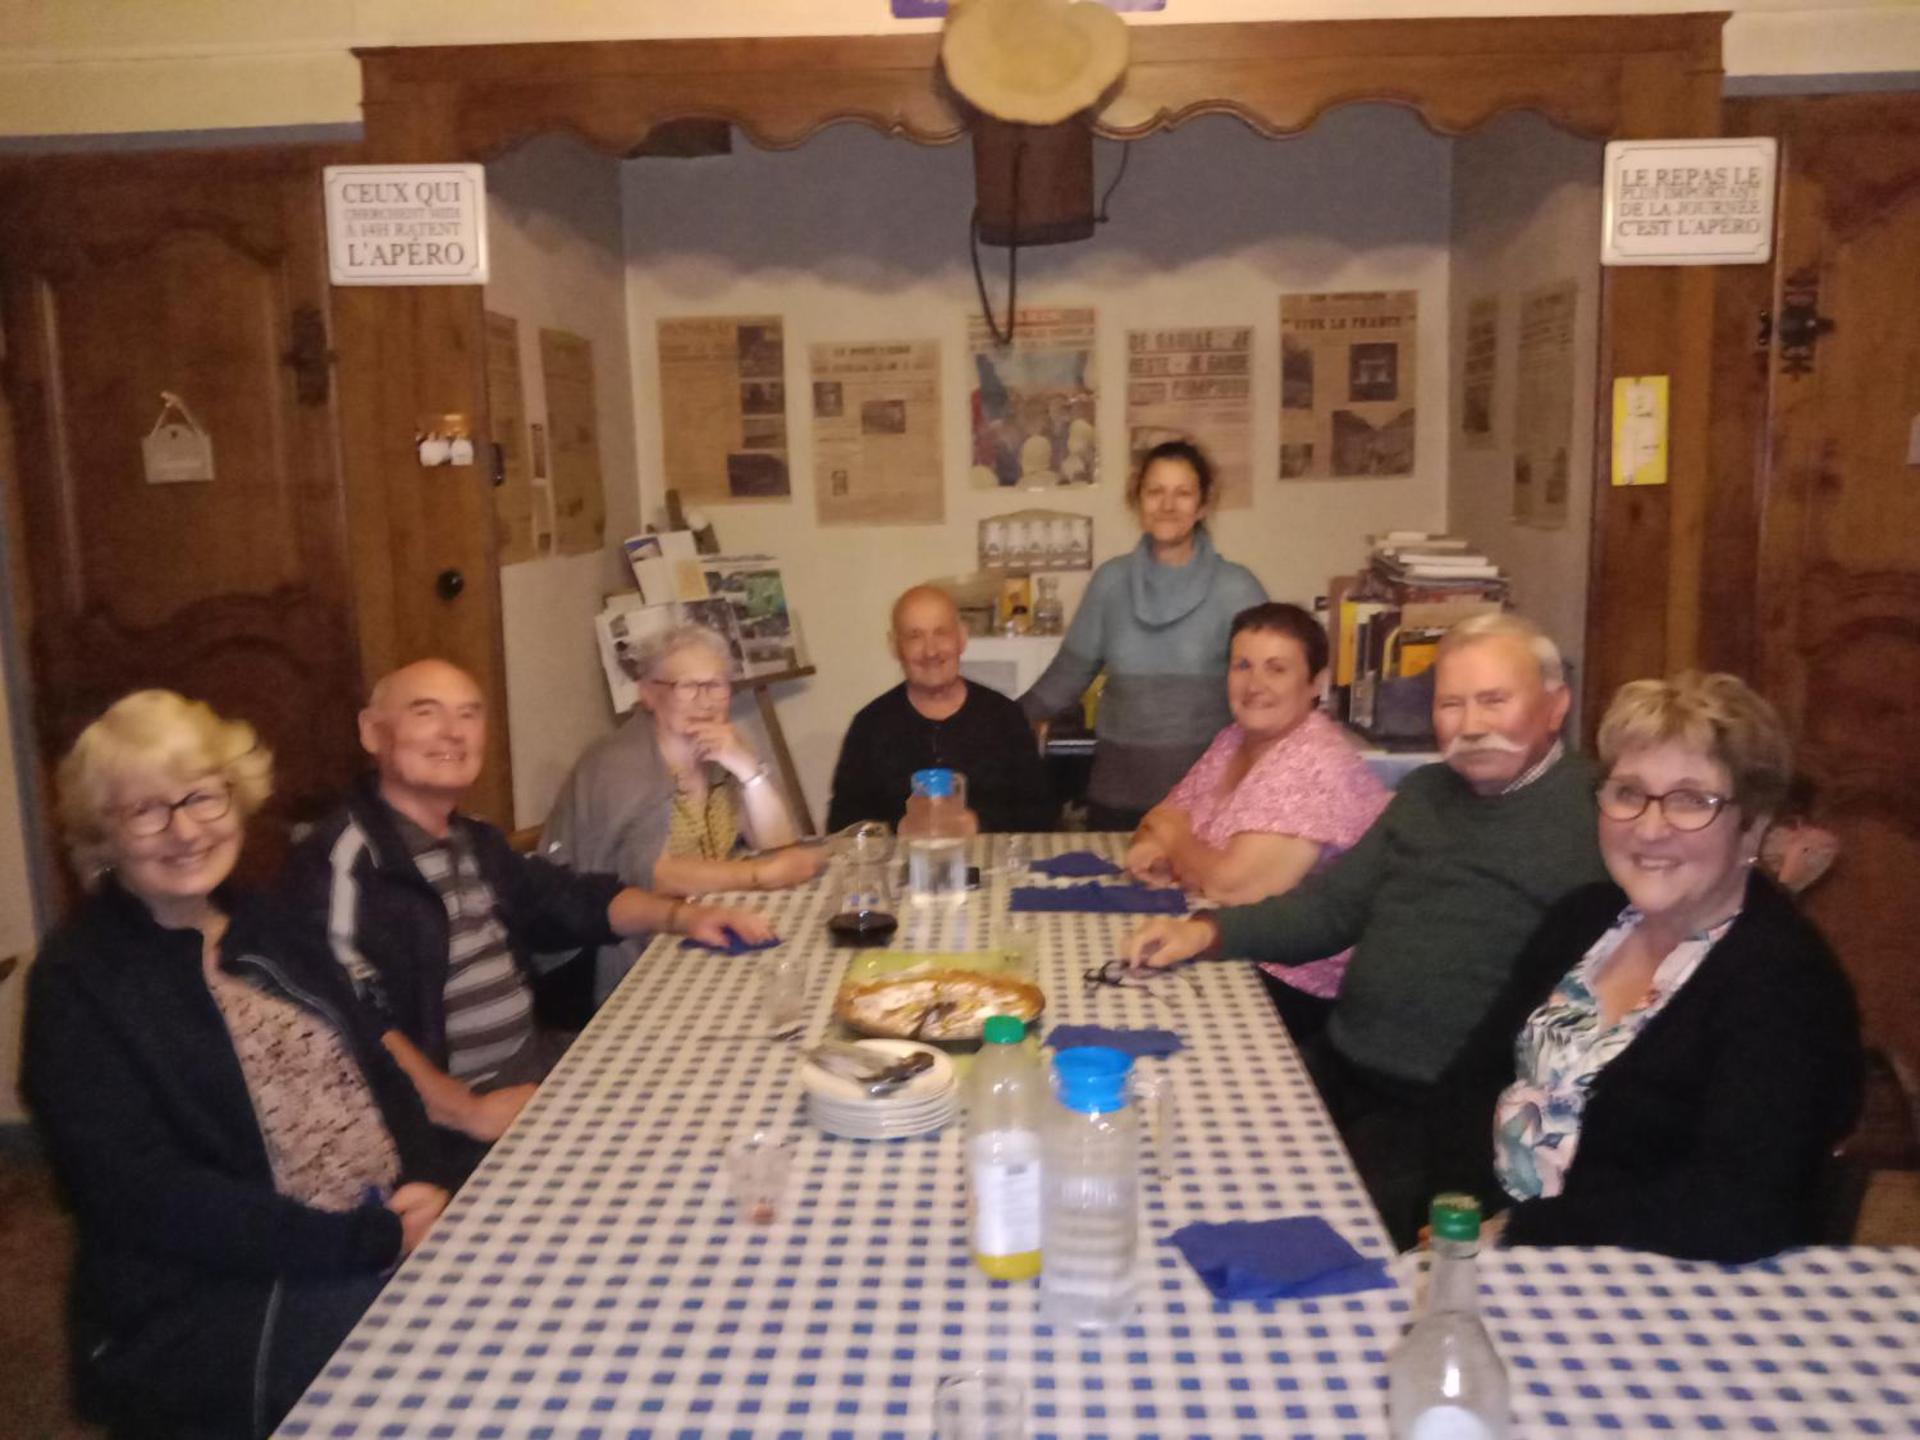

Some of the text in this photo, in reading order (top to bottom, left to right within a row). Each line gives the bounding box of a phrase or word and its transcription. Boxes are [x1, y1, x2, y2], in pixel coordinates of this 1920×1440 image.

[1621, 166, 1761, 187] LE REPAS LE
[342, 182, 461, 207] CEUX QUI
[1620, 202, 1644, 217] DE
[1648, 202, 1672, 217] LA
[1618, 219, 1673, 236] C'EST
[348, 236, 465, 267] L'APÉRO
